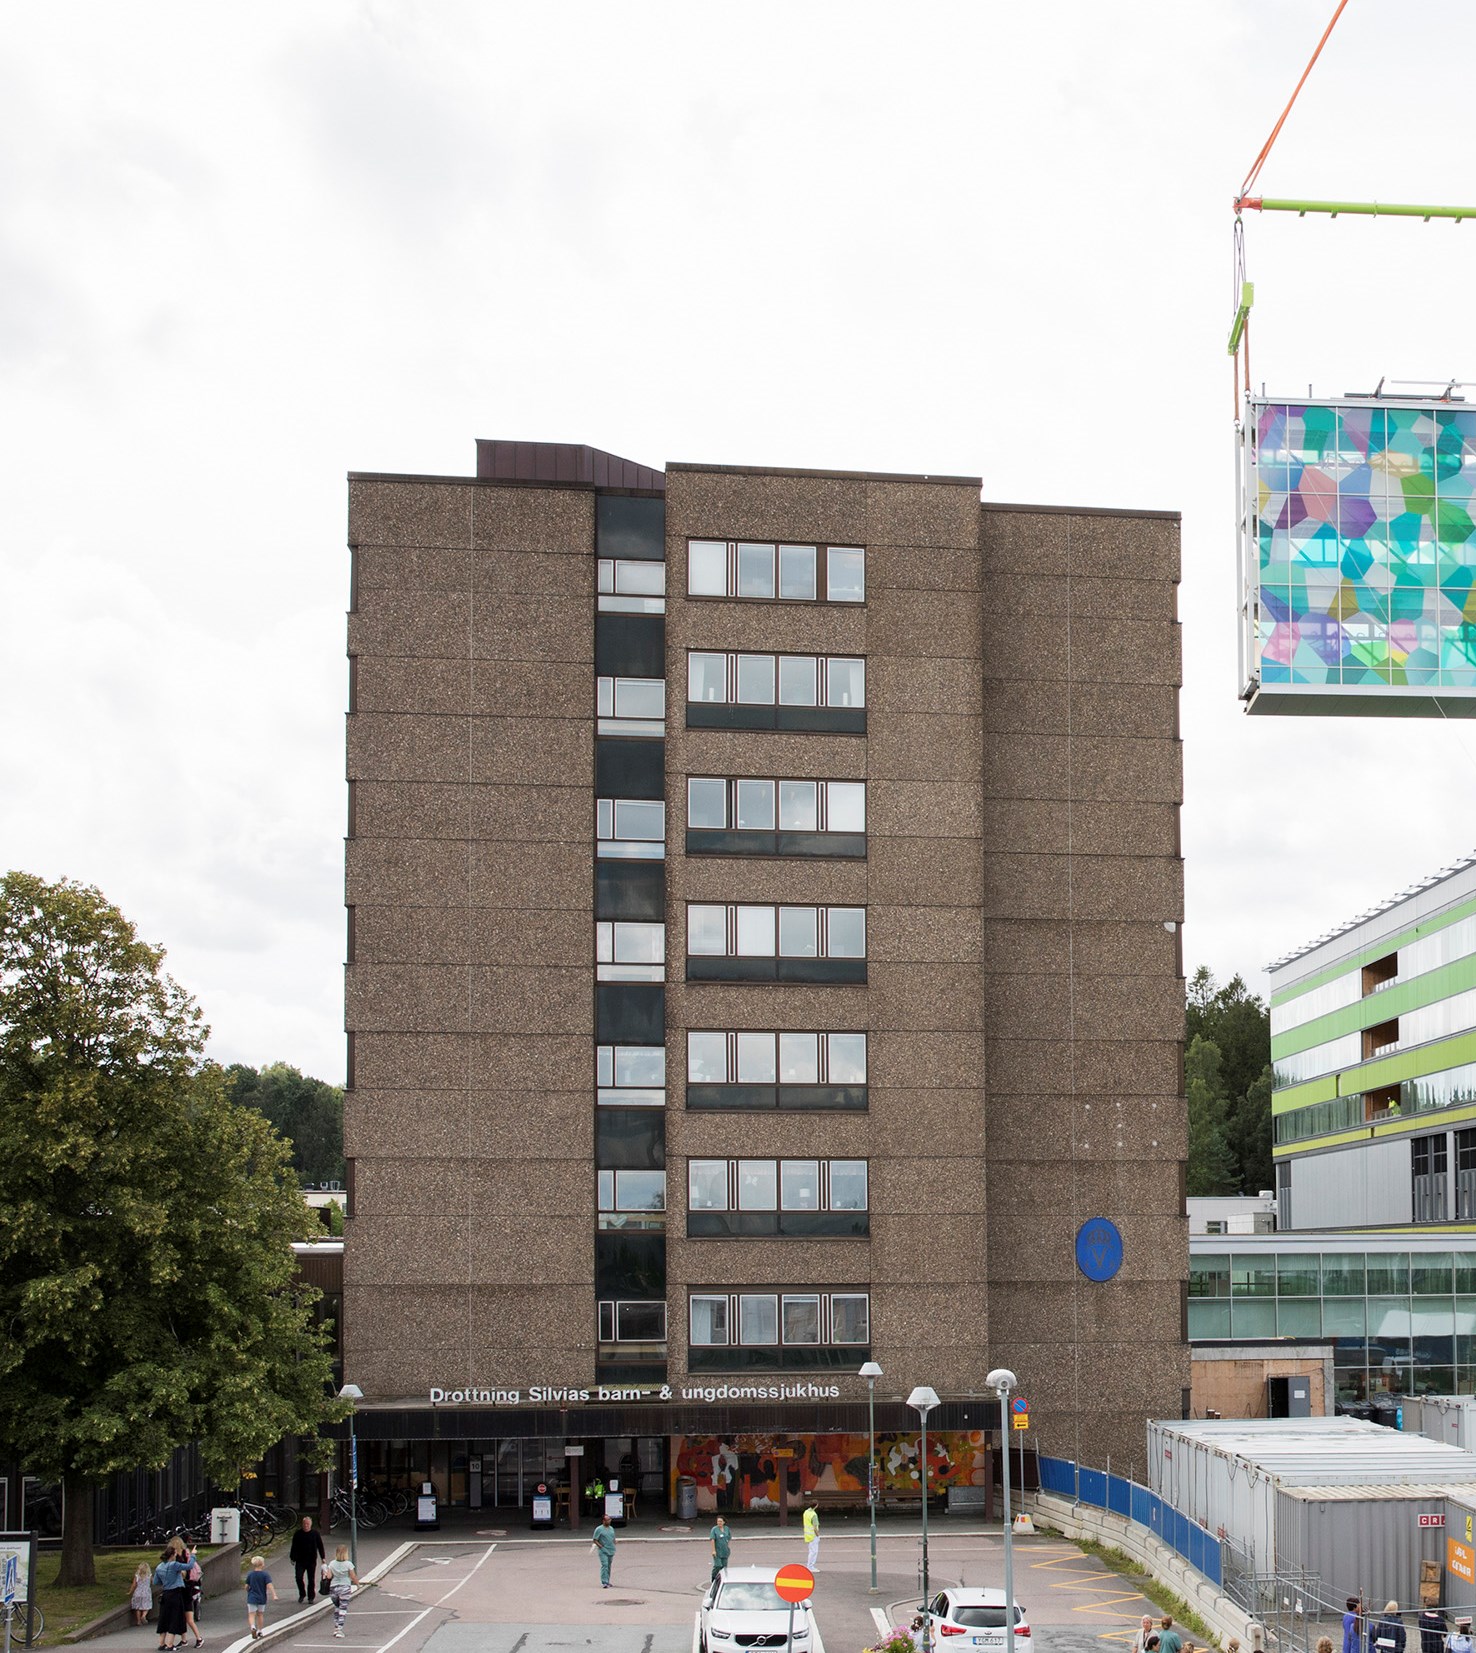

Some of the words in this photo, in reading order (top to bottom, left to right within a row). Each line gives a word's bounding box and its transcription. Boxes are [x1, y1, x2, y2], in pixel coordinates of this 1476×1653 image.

[430, 1387, 520, 1405] Drottning
[528, 1386, 590, 1402] Silvias
[598, 1386, 651, 1402] barn-
[659, 1385, 673, 1400] &
[682, 1383, 840, 1402] ungdomssjukhus
